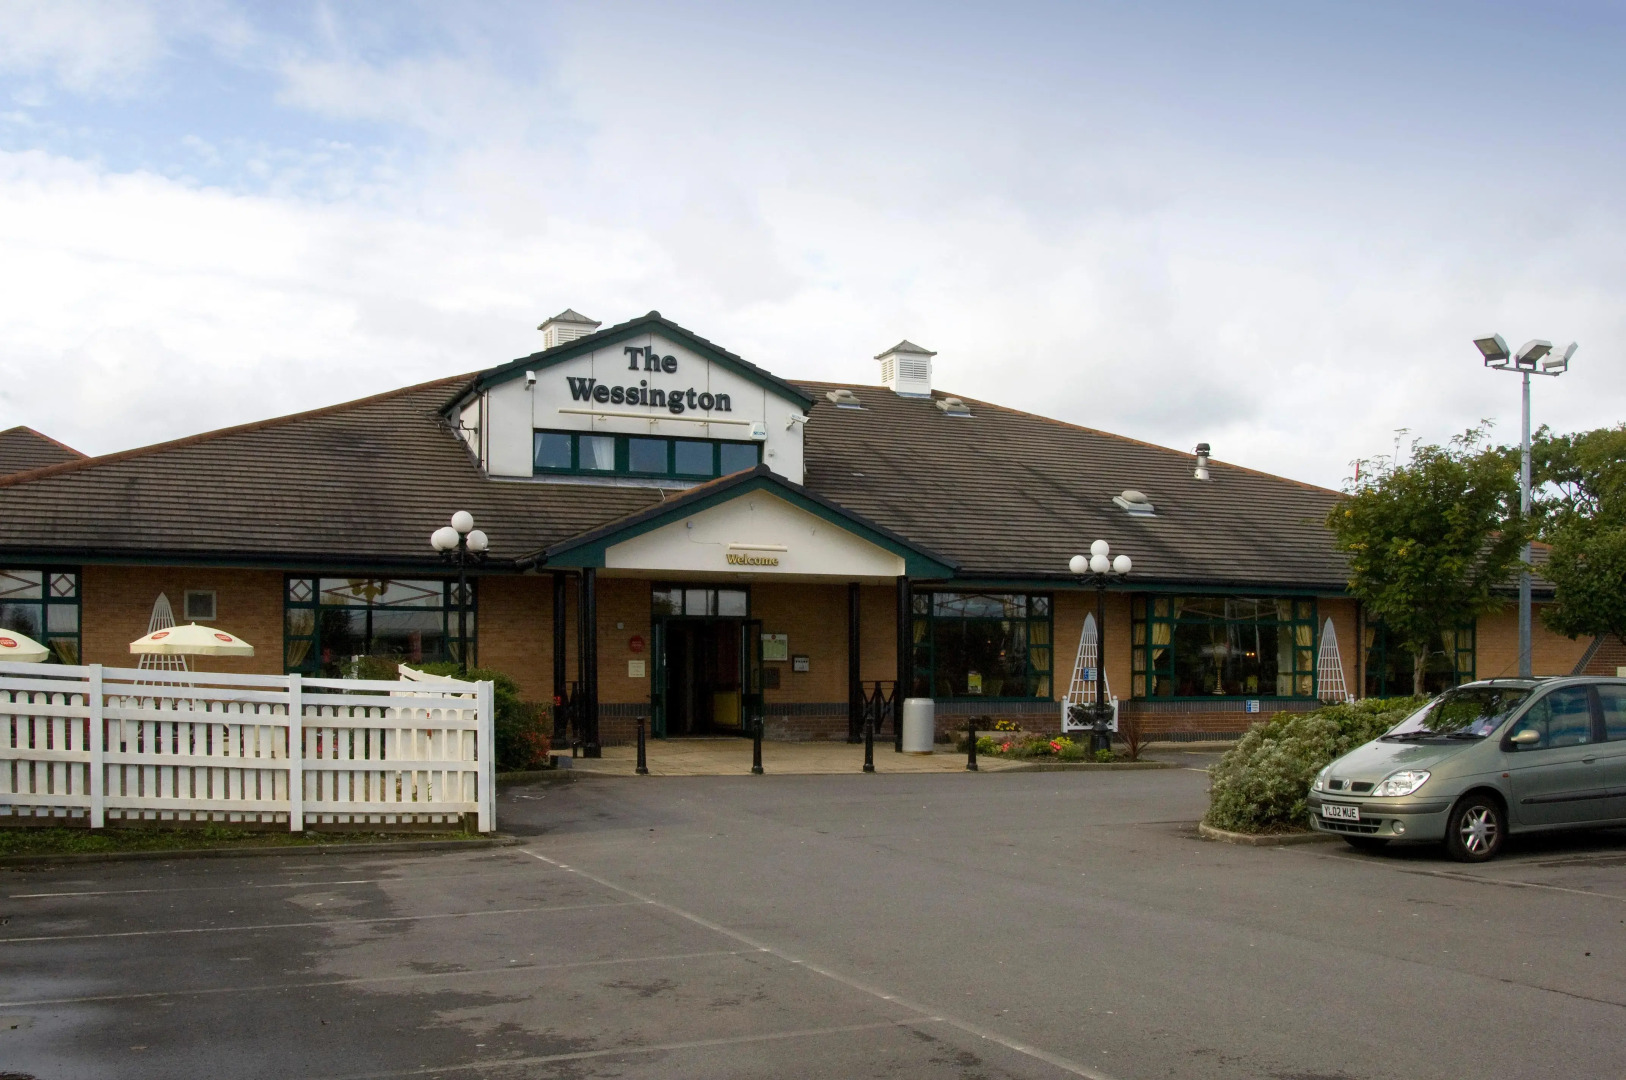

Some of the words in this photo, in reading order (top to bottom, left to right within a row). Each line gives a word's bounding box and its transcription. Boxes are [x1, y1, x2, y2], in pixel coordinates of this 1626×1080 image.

[624, 345, 678, 373] The
[566, 376, 732, 414] Wessington
[726, 553, 779, 567] Welcome
[1324, 806, 1341, 817] YL02
[1342, 807, 1357, 819] MUE
